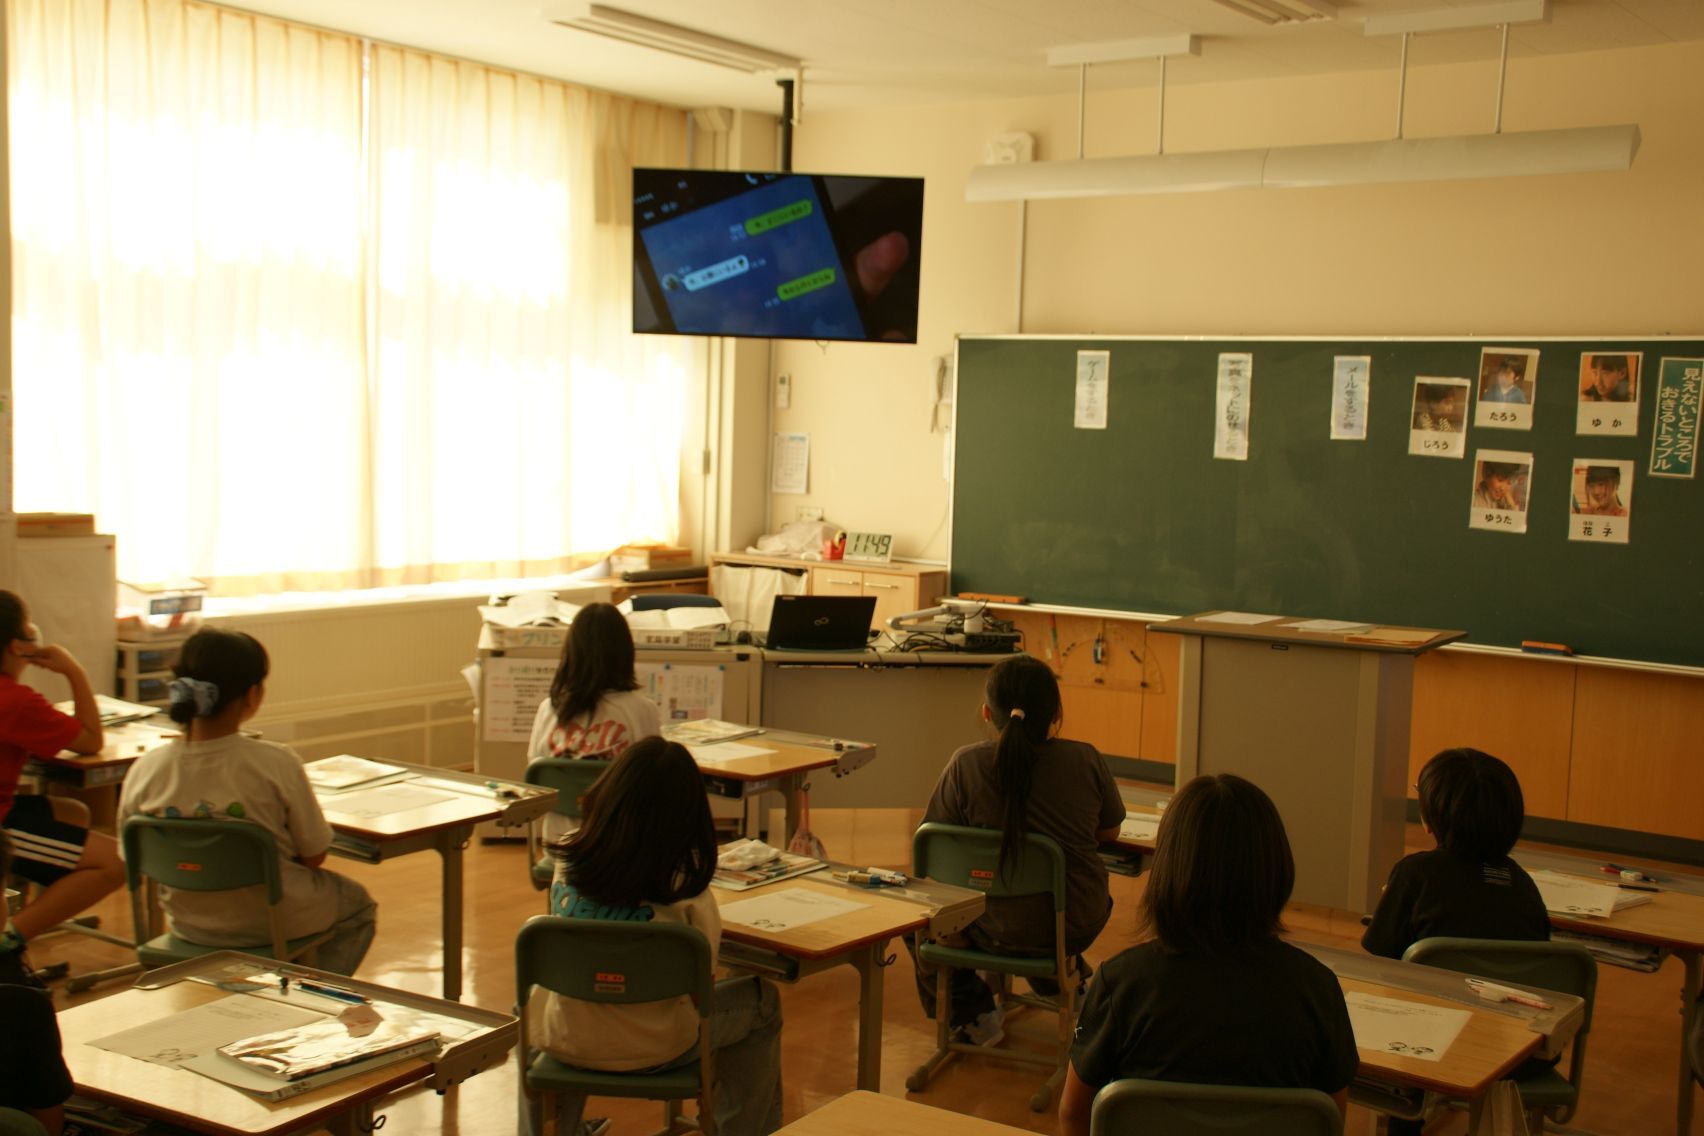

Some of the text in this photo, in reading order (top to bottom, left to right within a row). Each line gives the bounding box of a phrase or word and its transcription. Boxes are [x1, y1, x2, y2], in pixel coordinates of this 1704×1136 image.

[1489, 411, 1517, 422] たろう
[1674, 367, 1701, 463] 見えないところで
[1654, 386, 1680, 470] おきるトラブル
[1424, 440, 1449, 450] じろう
[1485, 513, 1512, 525] ゆうた
